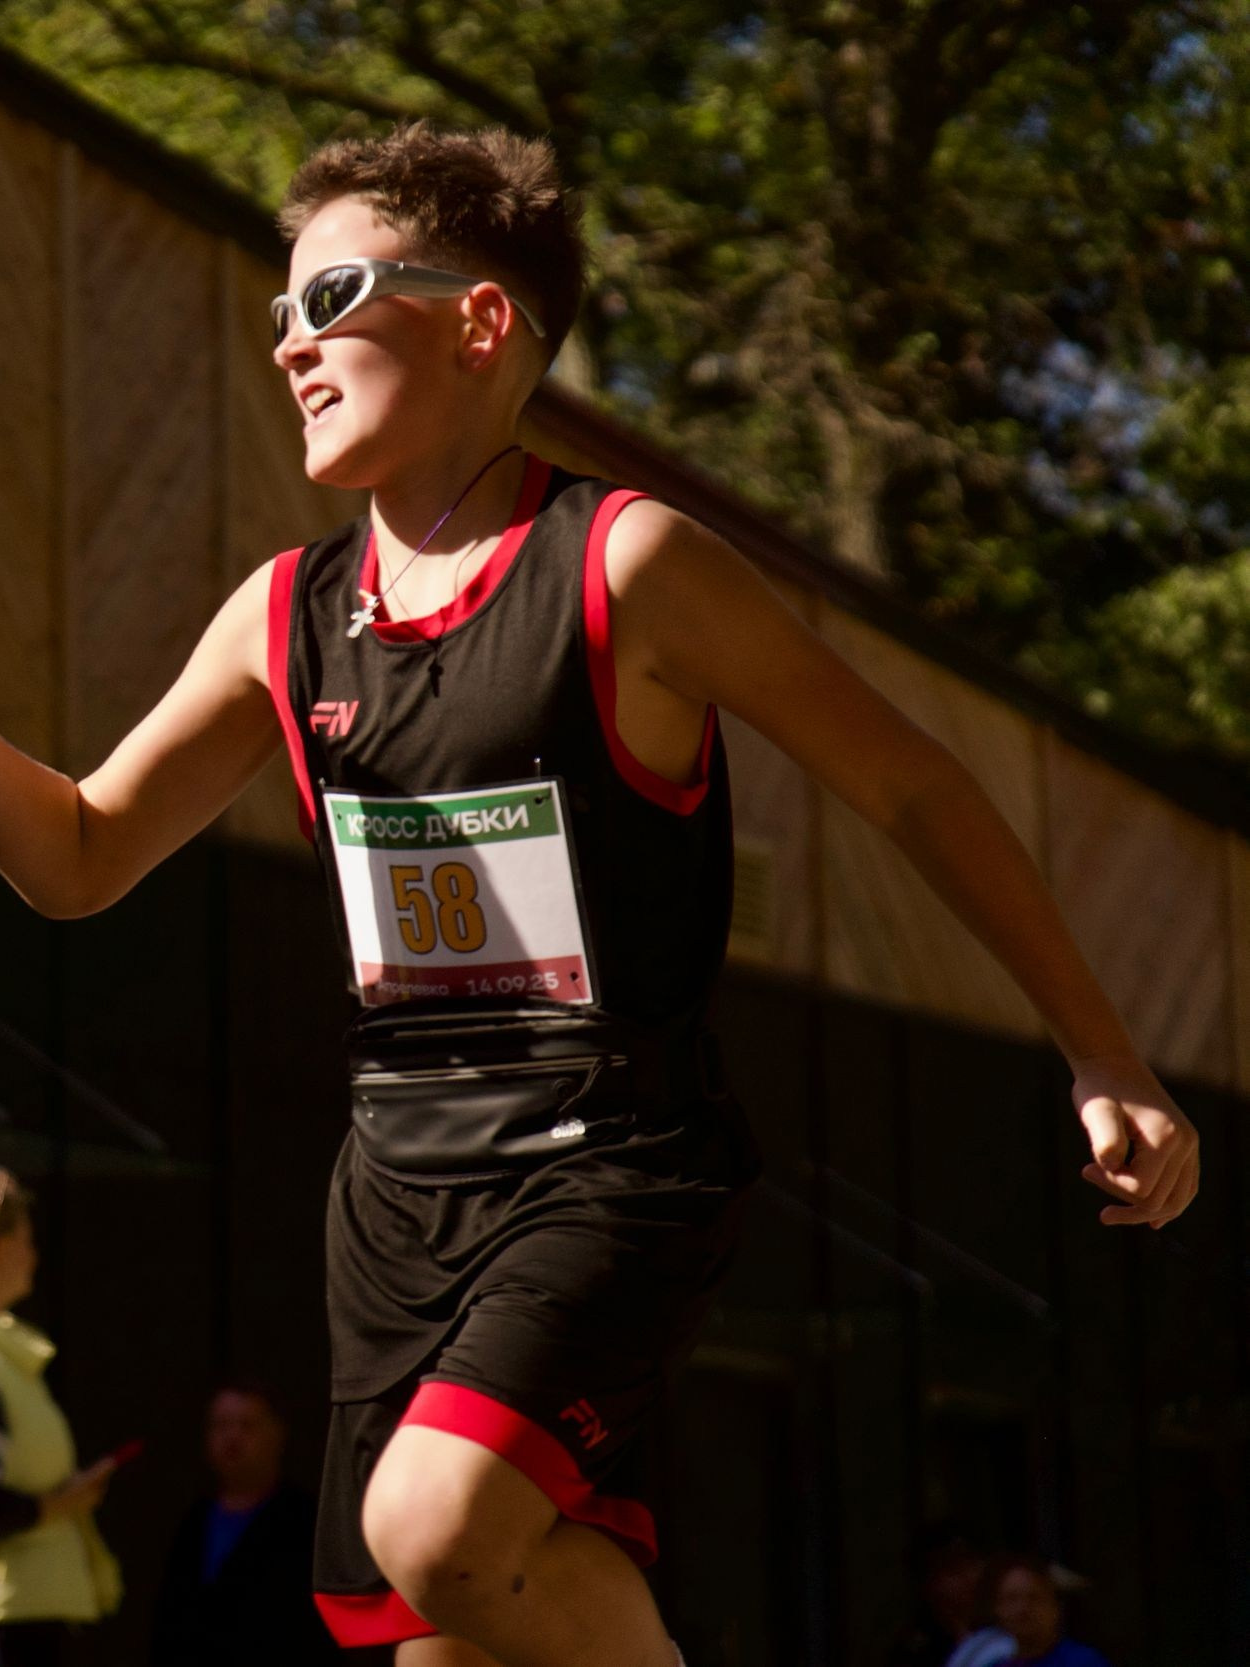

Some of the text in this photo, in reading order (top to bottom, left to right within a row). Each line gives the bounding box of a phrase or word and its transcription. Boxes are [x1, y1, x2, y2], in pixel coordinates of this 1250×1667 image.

[347, 804, 530, 842] КРОСС ДУБКИ
[389, 862, 487, 955] 58
[465, 971, 559, 996] 14.09.25
